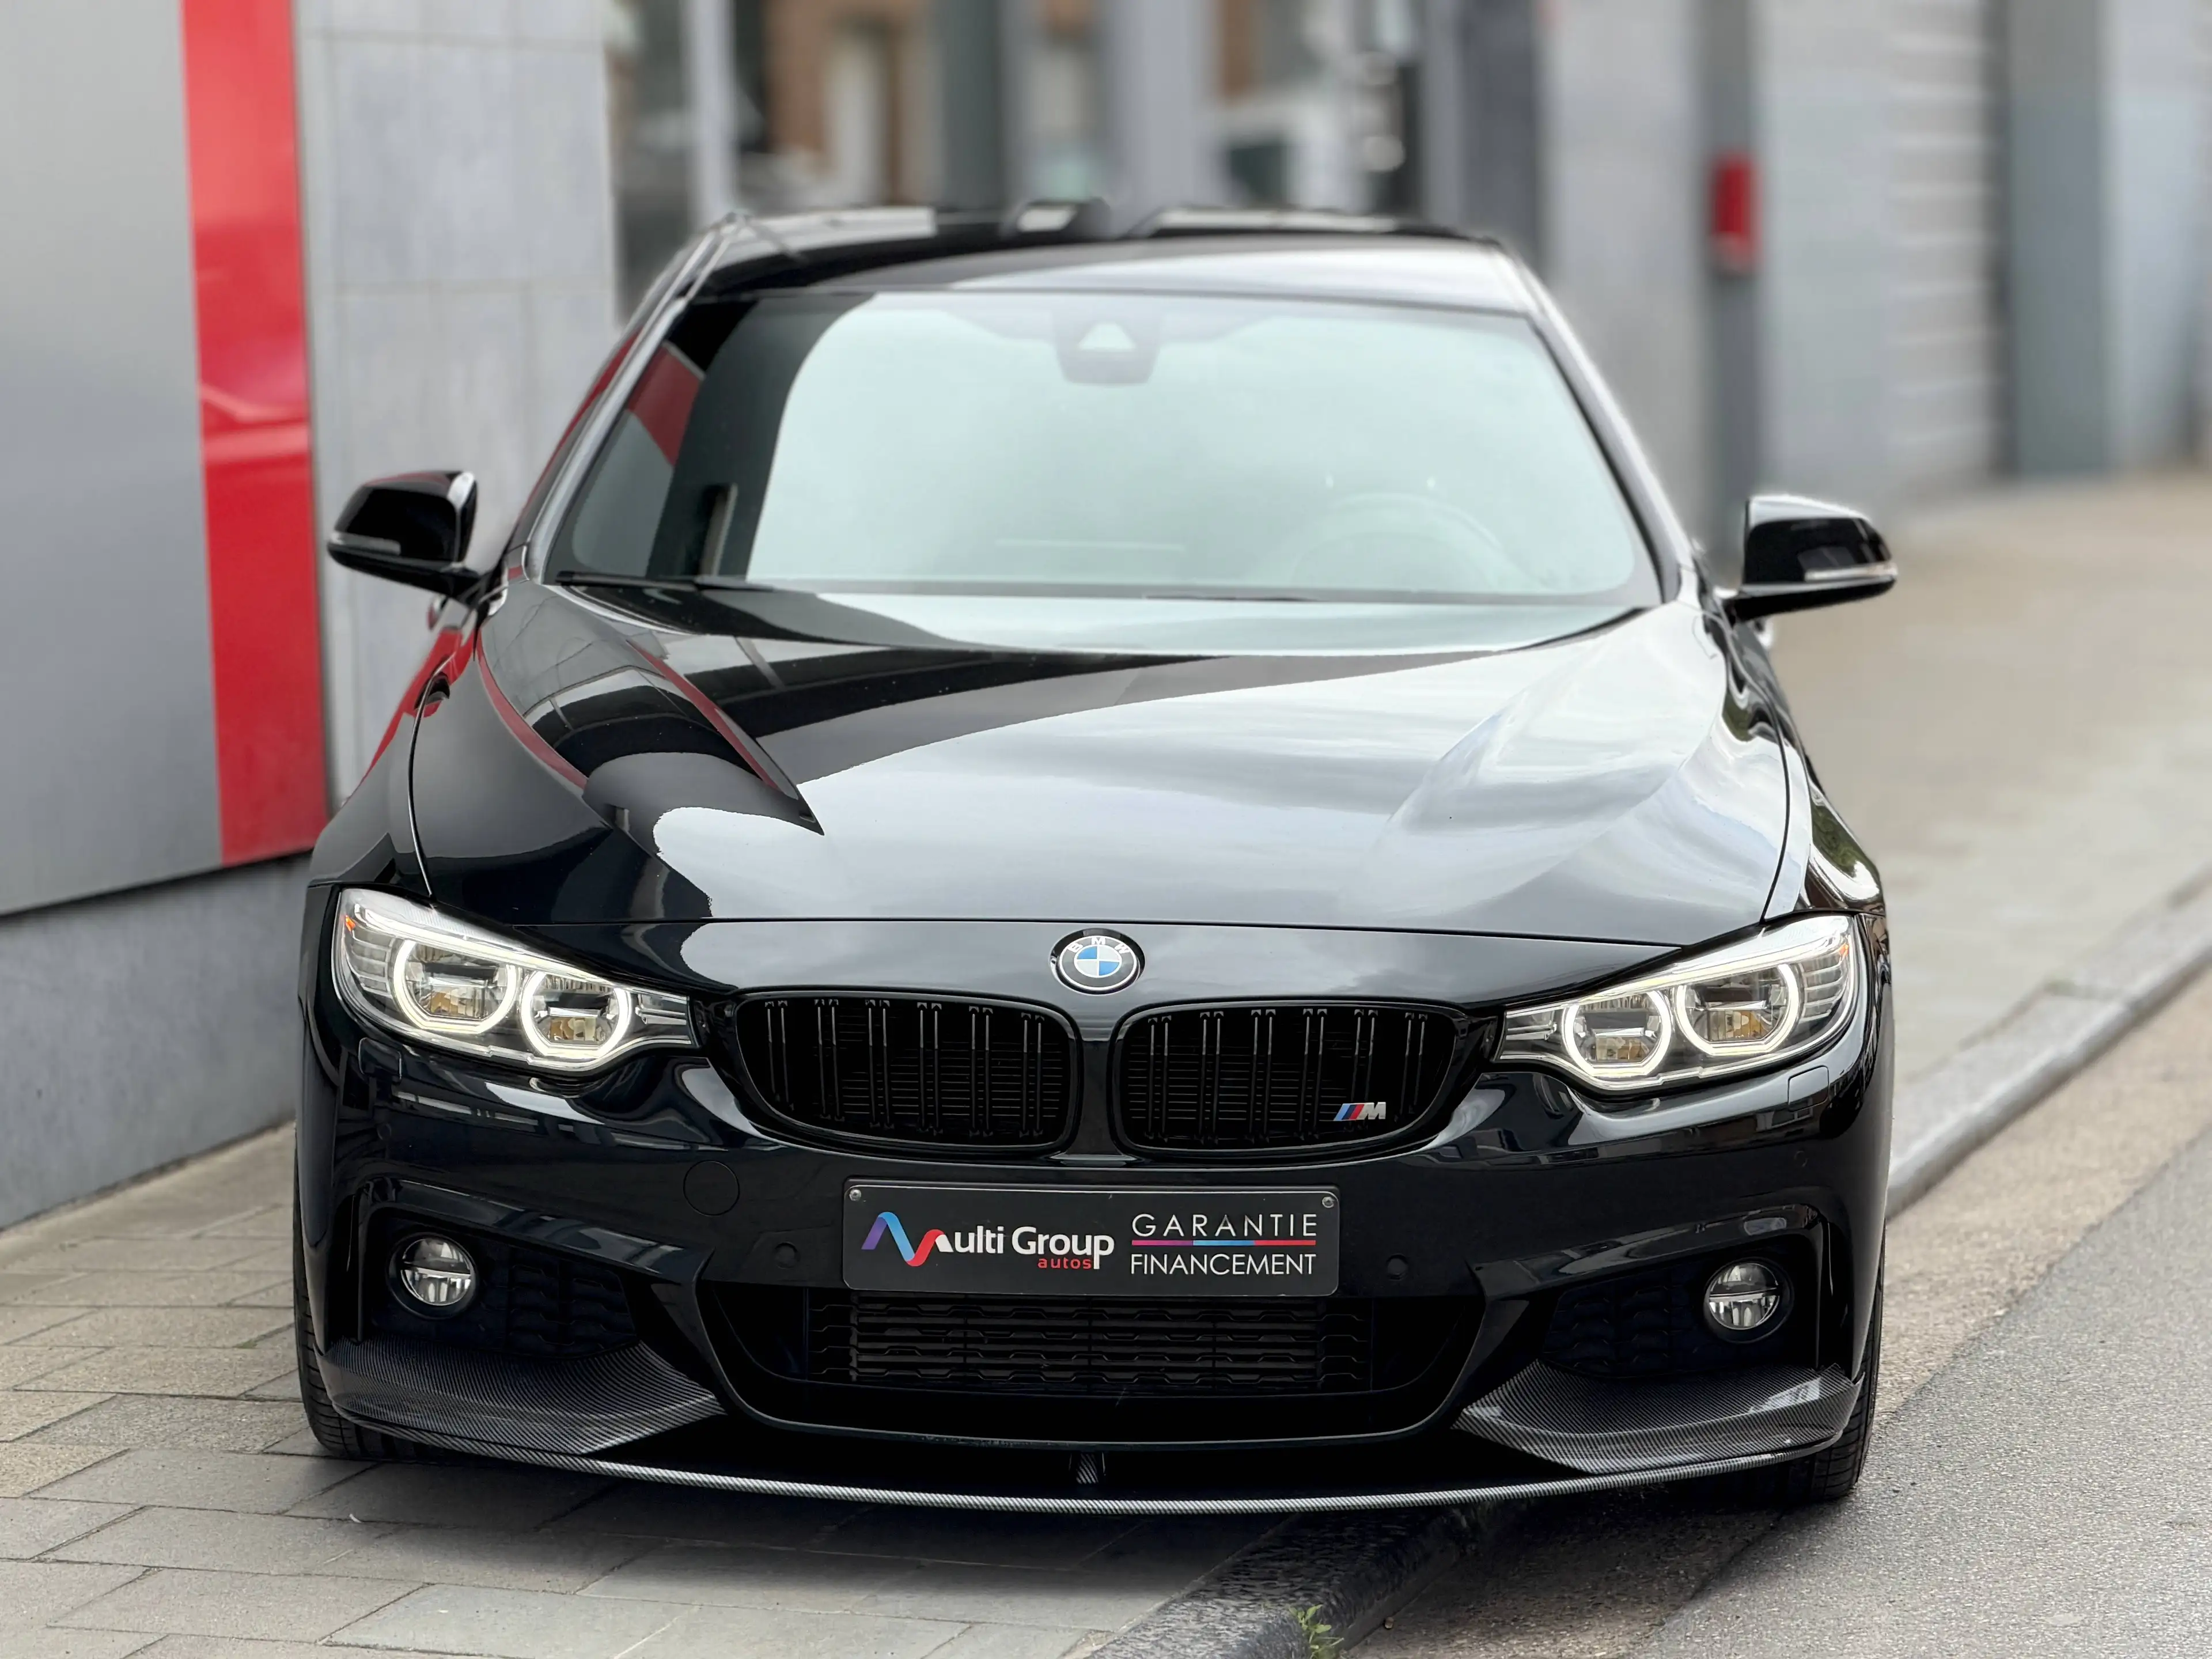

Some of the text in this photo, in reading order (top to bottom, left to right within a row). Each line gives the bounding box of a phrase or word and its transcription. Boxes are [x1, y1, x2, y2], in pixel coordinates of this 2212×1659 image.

[1067, 937, 1131, 953] BMW
[1131, 1213, 1317, 1237] GARANTIE
[1012, 1226, 1115, 1270] Group
[1037, 1257, 1092, 1270] autos
[1131, 1253, 1316, 1275] FINANCEMENT
